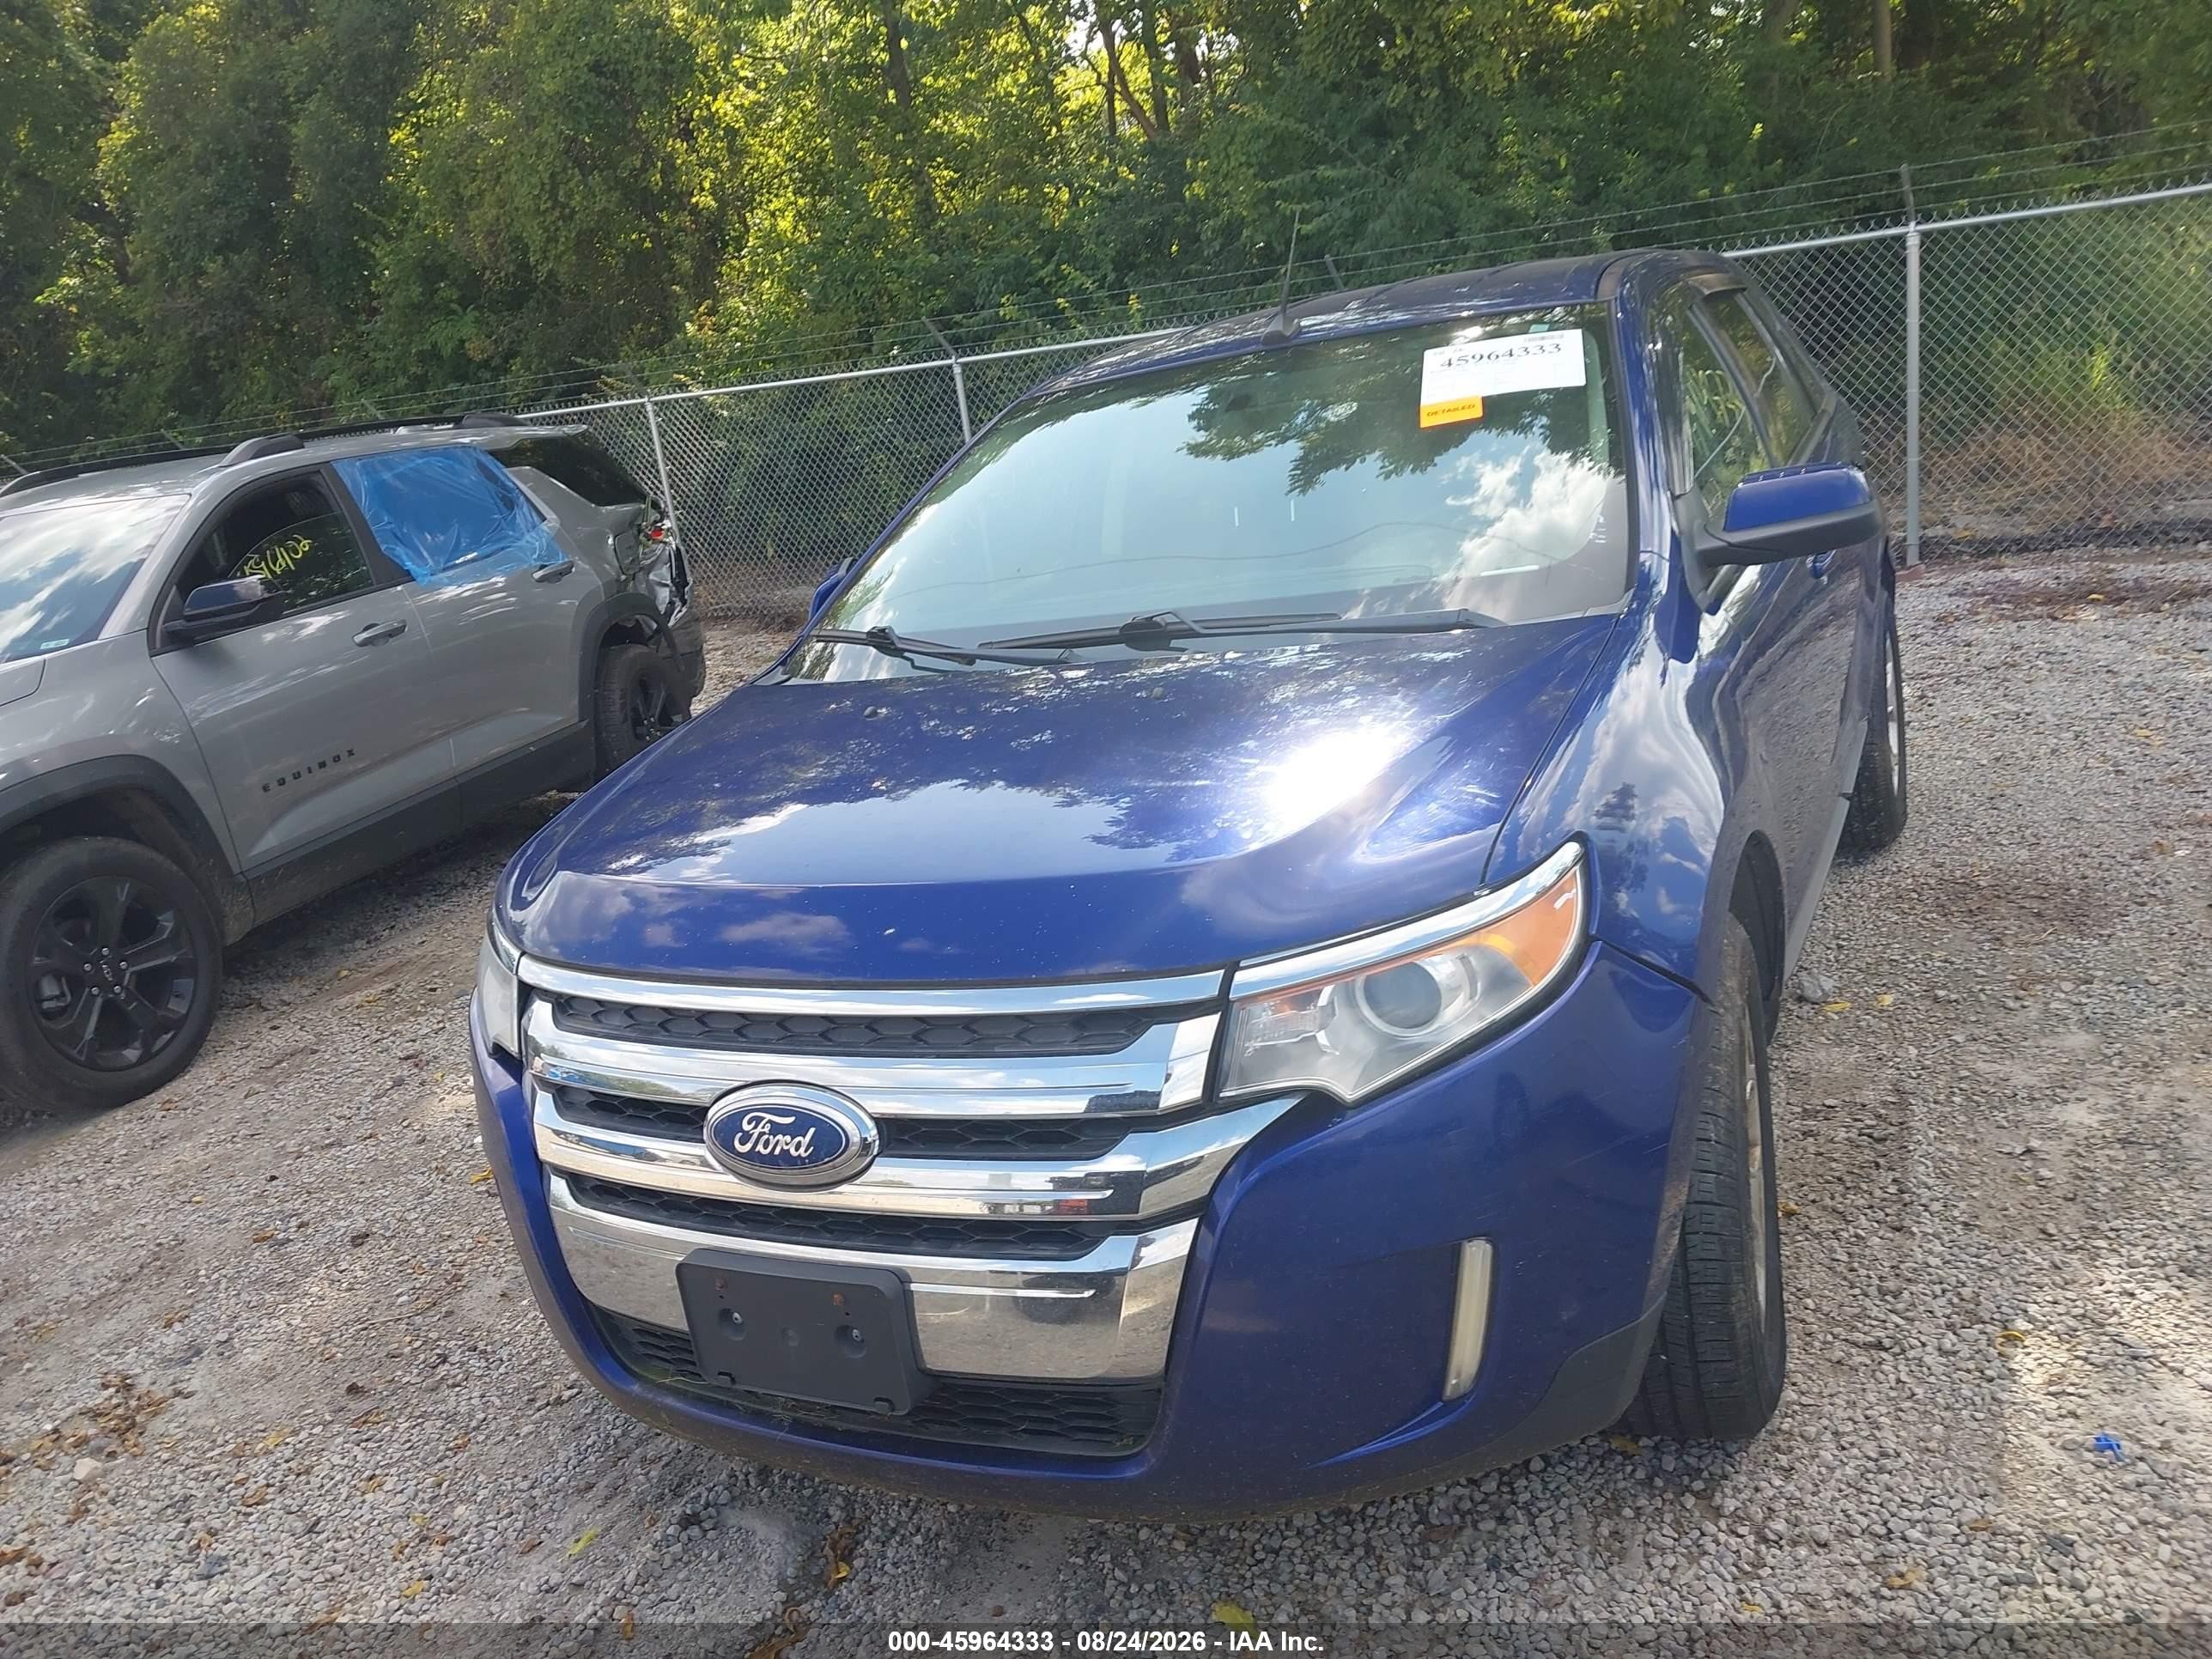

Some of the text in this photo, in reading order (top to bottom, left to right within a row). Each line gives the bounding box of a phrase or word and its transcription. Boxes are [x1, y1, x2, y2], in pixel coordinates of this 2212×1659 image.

[1440, 343, 1561, 368] 45964333
[262, 749, 356, 793] EQUINOX
[733, 1112, 816, 1158] Ford
